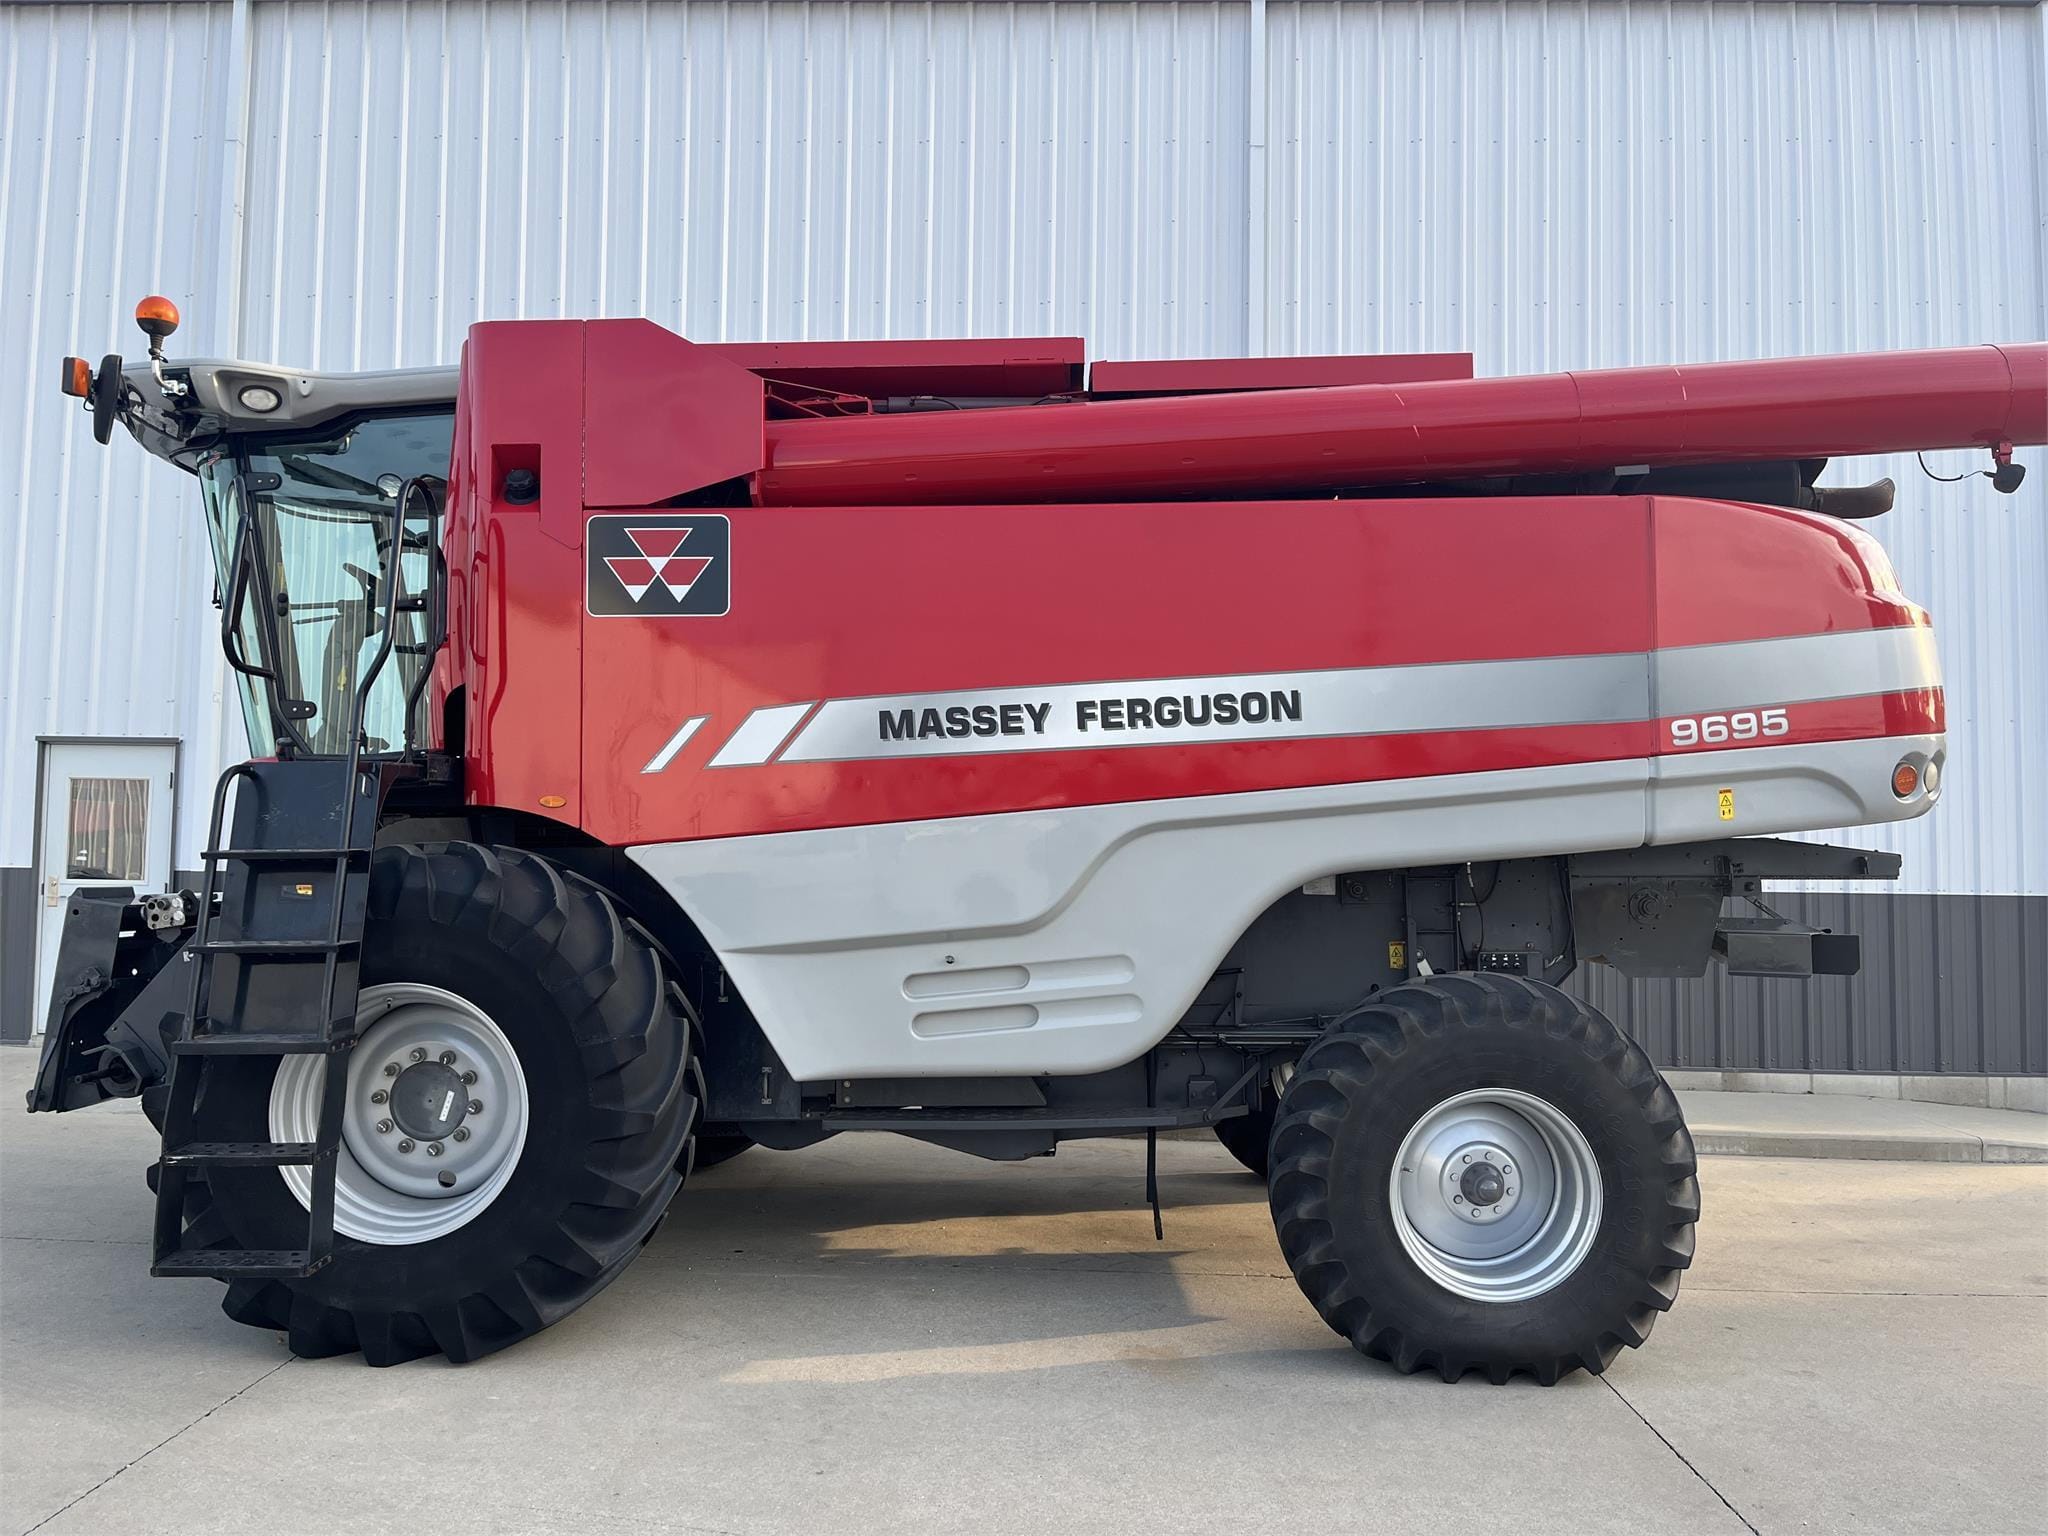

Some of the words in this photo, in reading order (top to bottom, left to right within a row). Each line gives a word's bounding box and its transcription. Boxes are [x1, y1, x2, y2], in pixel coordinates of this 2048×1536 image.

[878, 702, 1050, 741] MASSEY
[1076, 690, 1302, 731] FERGUSON
[1670, 708, 1789, 746] 9695
